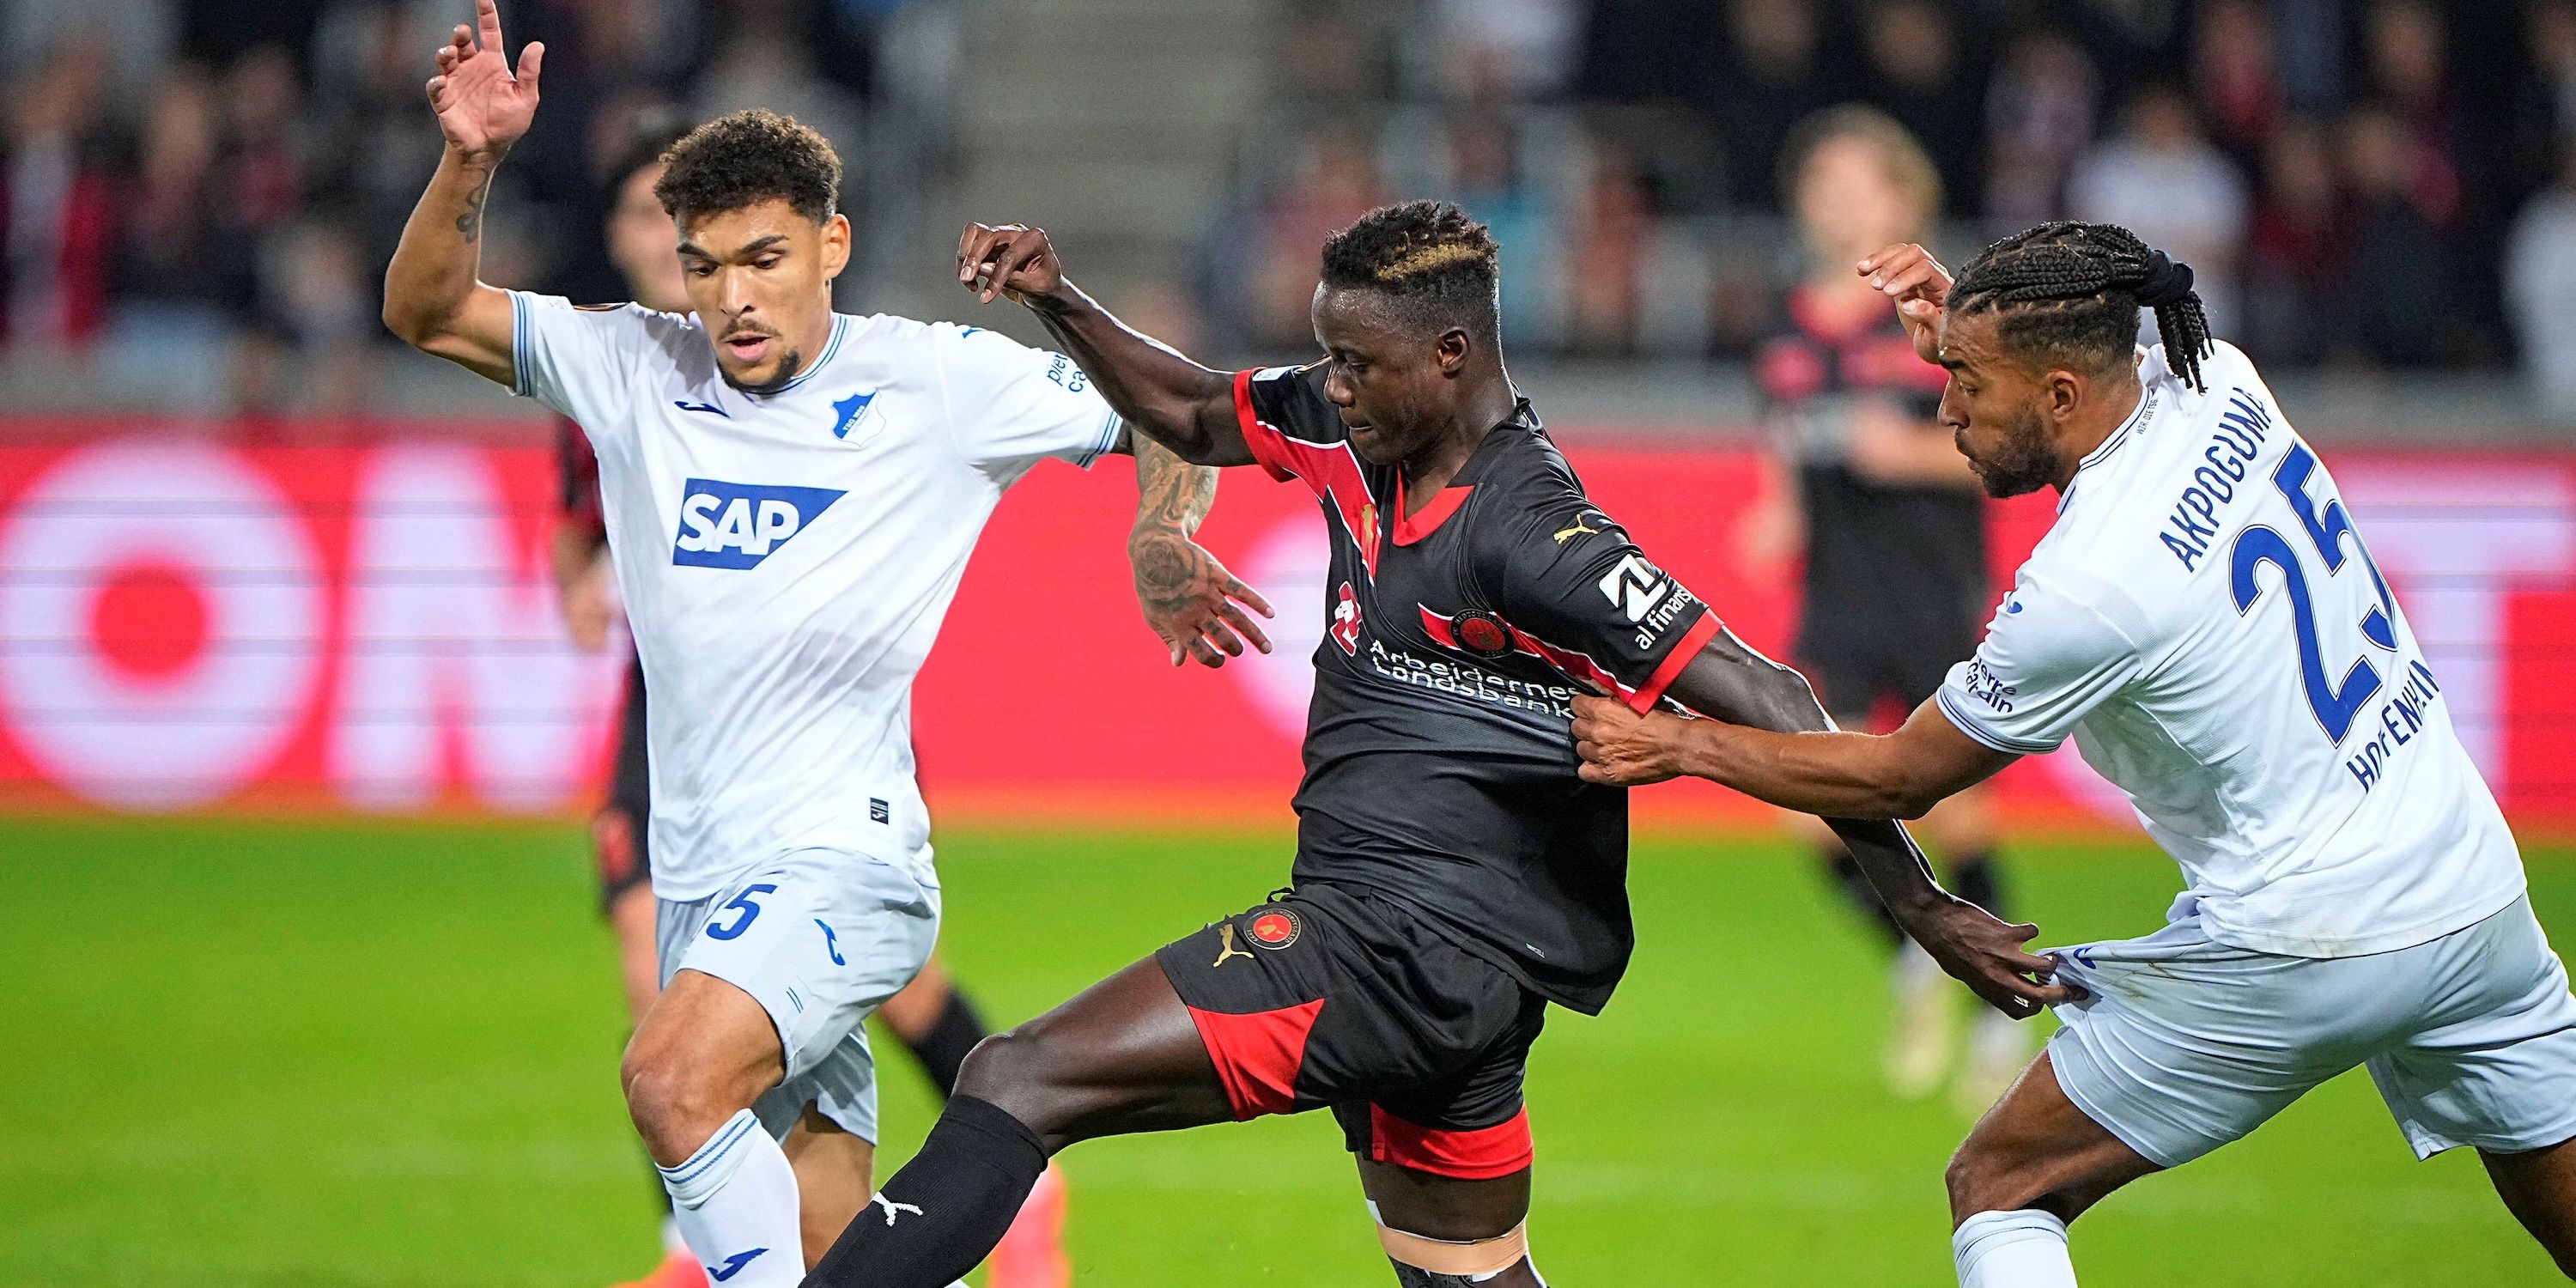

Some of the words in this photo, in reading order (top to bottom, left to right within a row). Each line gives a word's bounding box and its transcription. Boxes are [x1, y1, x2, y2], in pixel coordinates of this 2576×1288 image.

[676, 493, 800, 556] SAP
[1635, 625, 1656, 650] al
[1646, 589, 1692, 633] finans
[2229, 437, 2399, 749] 25
[1372, 655, 1576, 720] Landsbank
[706, 884, 778, 941] 5
